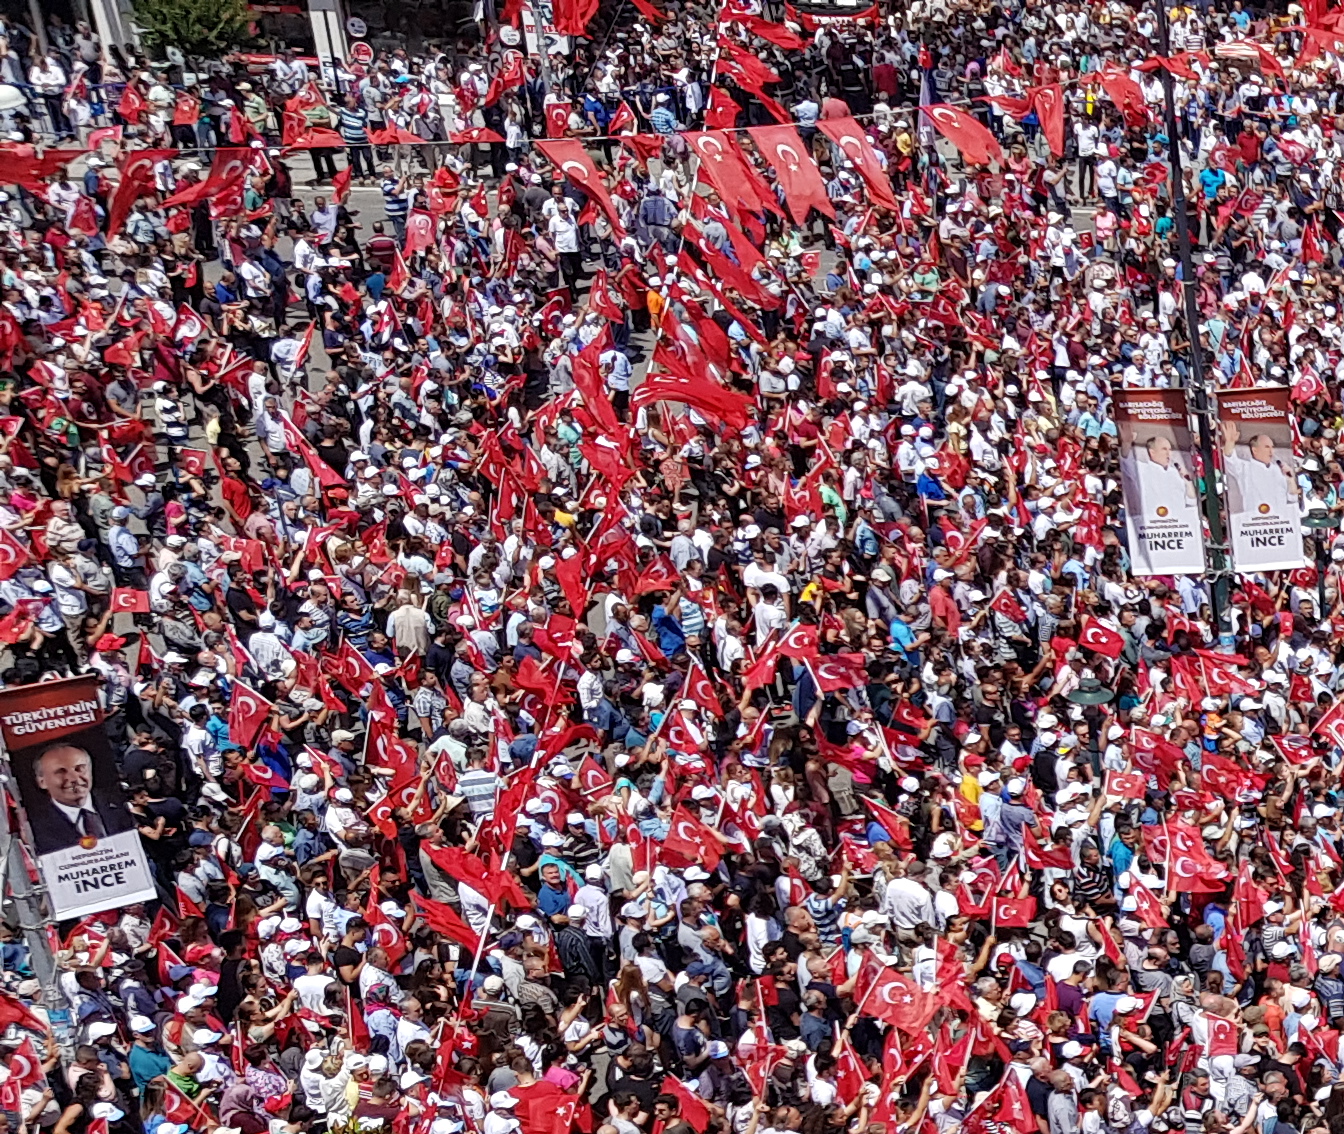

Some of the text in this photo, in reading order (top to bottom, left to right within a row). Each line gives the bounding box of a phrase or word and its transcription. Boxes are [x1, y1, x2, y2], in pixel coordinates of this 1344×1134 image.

[1138, 530, 1193, 541] MUHARREM
[1240, 527, 1294, 538] MUHARREM
[1149, 538, 1184, 551] İNCE
[1251, 535, 1285, 548] İNCE
[12, 711, 97, 736] GÜVENCESİ
[57, 859, 137, 883] MUHARREM
[74, 871, 126, 893] İNCE
